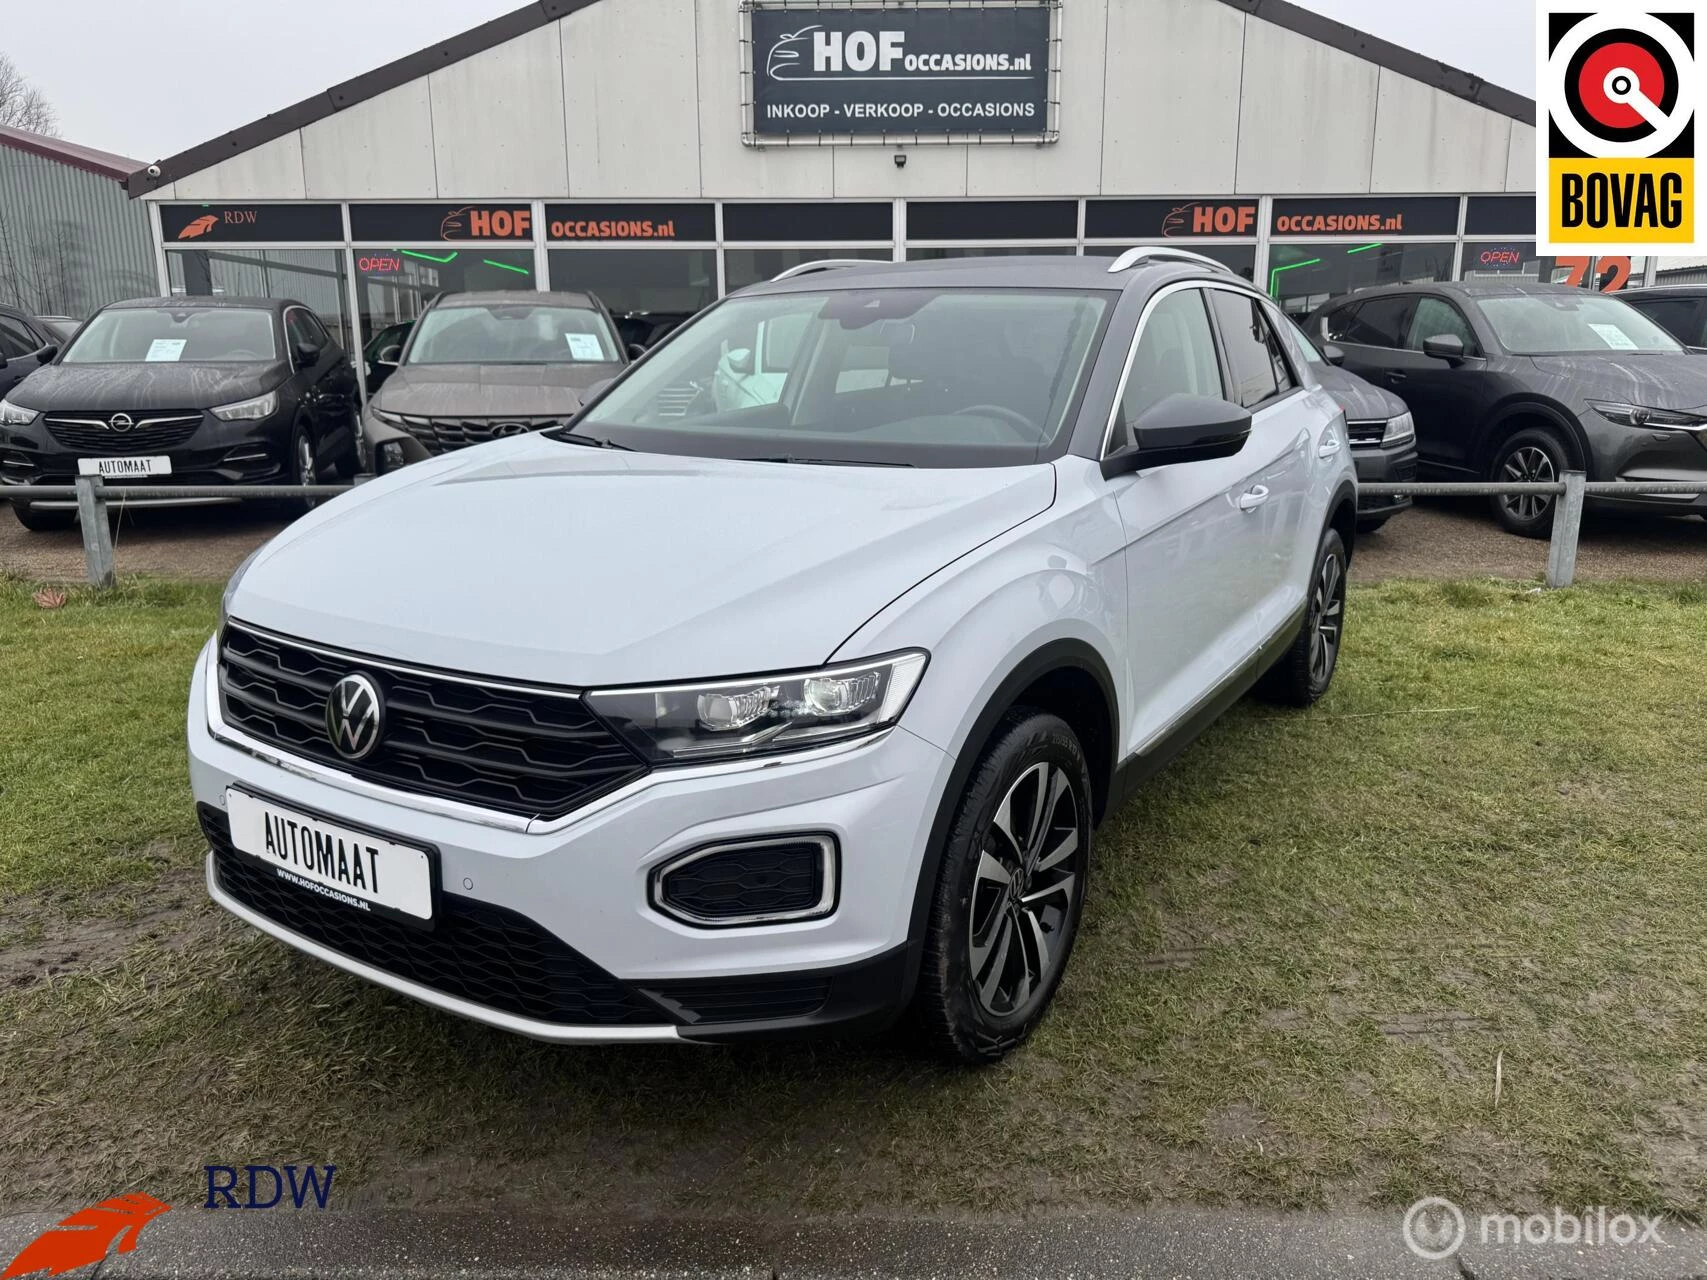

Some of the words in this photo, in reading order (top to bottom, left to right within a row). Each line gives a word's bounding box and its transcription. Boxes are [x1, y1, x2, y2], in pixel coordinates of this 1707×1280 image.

[813, 31, 905, 72] HOF
[904, 53, 1031, 71] OCCASIONS.nl
[767, 103, 830, 119] INKOOP
[843, 103, 924, 118] VERKOOP
[937, 102, 1035, 118] OCCASIONS
[224, 211, 258, 224] RDW
[470, 210, 530, 236] HOF
[551, 220, 675, 237] OCCASIONS.nl
[1192, 206, 1255, 233] HOF
[1276, 214, 1403, 232] OCCASIONS.nl
[358, 256, 401, 271] OPEN
[1480, 250, 1520, 263] OPEN
[98, 459, 151, 474] AUTOMAAT
[264, 811, 379, 894] AUTOMAAT
[276, 868, 371, 912] WWW.HOFOCCASIONS.NL
